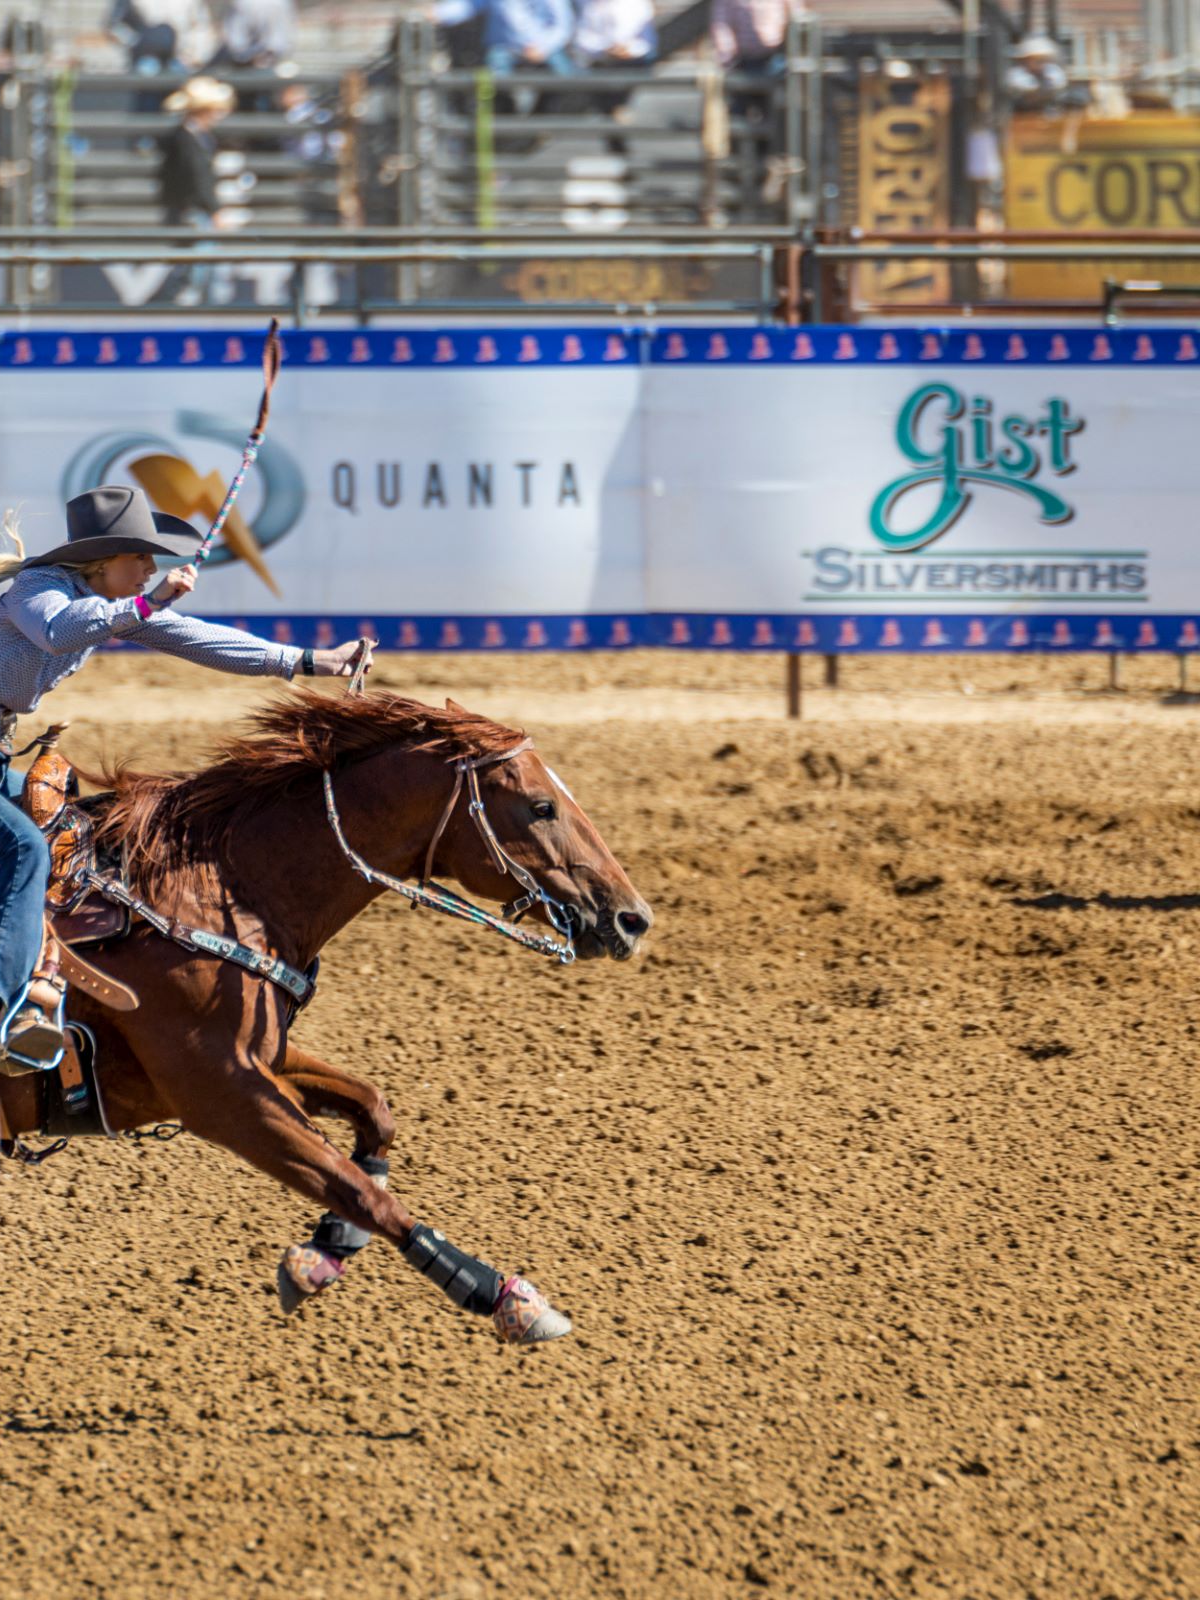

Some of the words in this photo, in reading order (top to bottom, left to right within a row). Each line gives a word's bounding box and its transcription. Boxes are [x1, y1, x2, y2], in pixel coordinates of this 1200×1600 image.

[1046, 159, 1200, 227] COR
[332, 461, 583, 514] QUANTA
[868, 379, 1086, 553] Gist
[811, 546, 1148, 592] SILVERSMITHS
